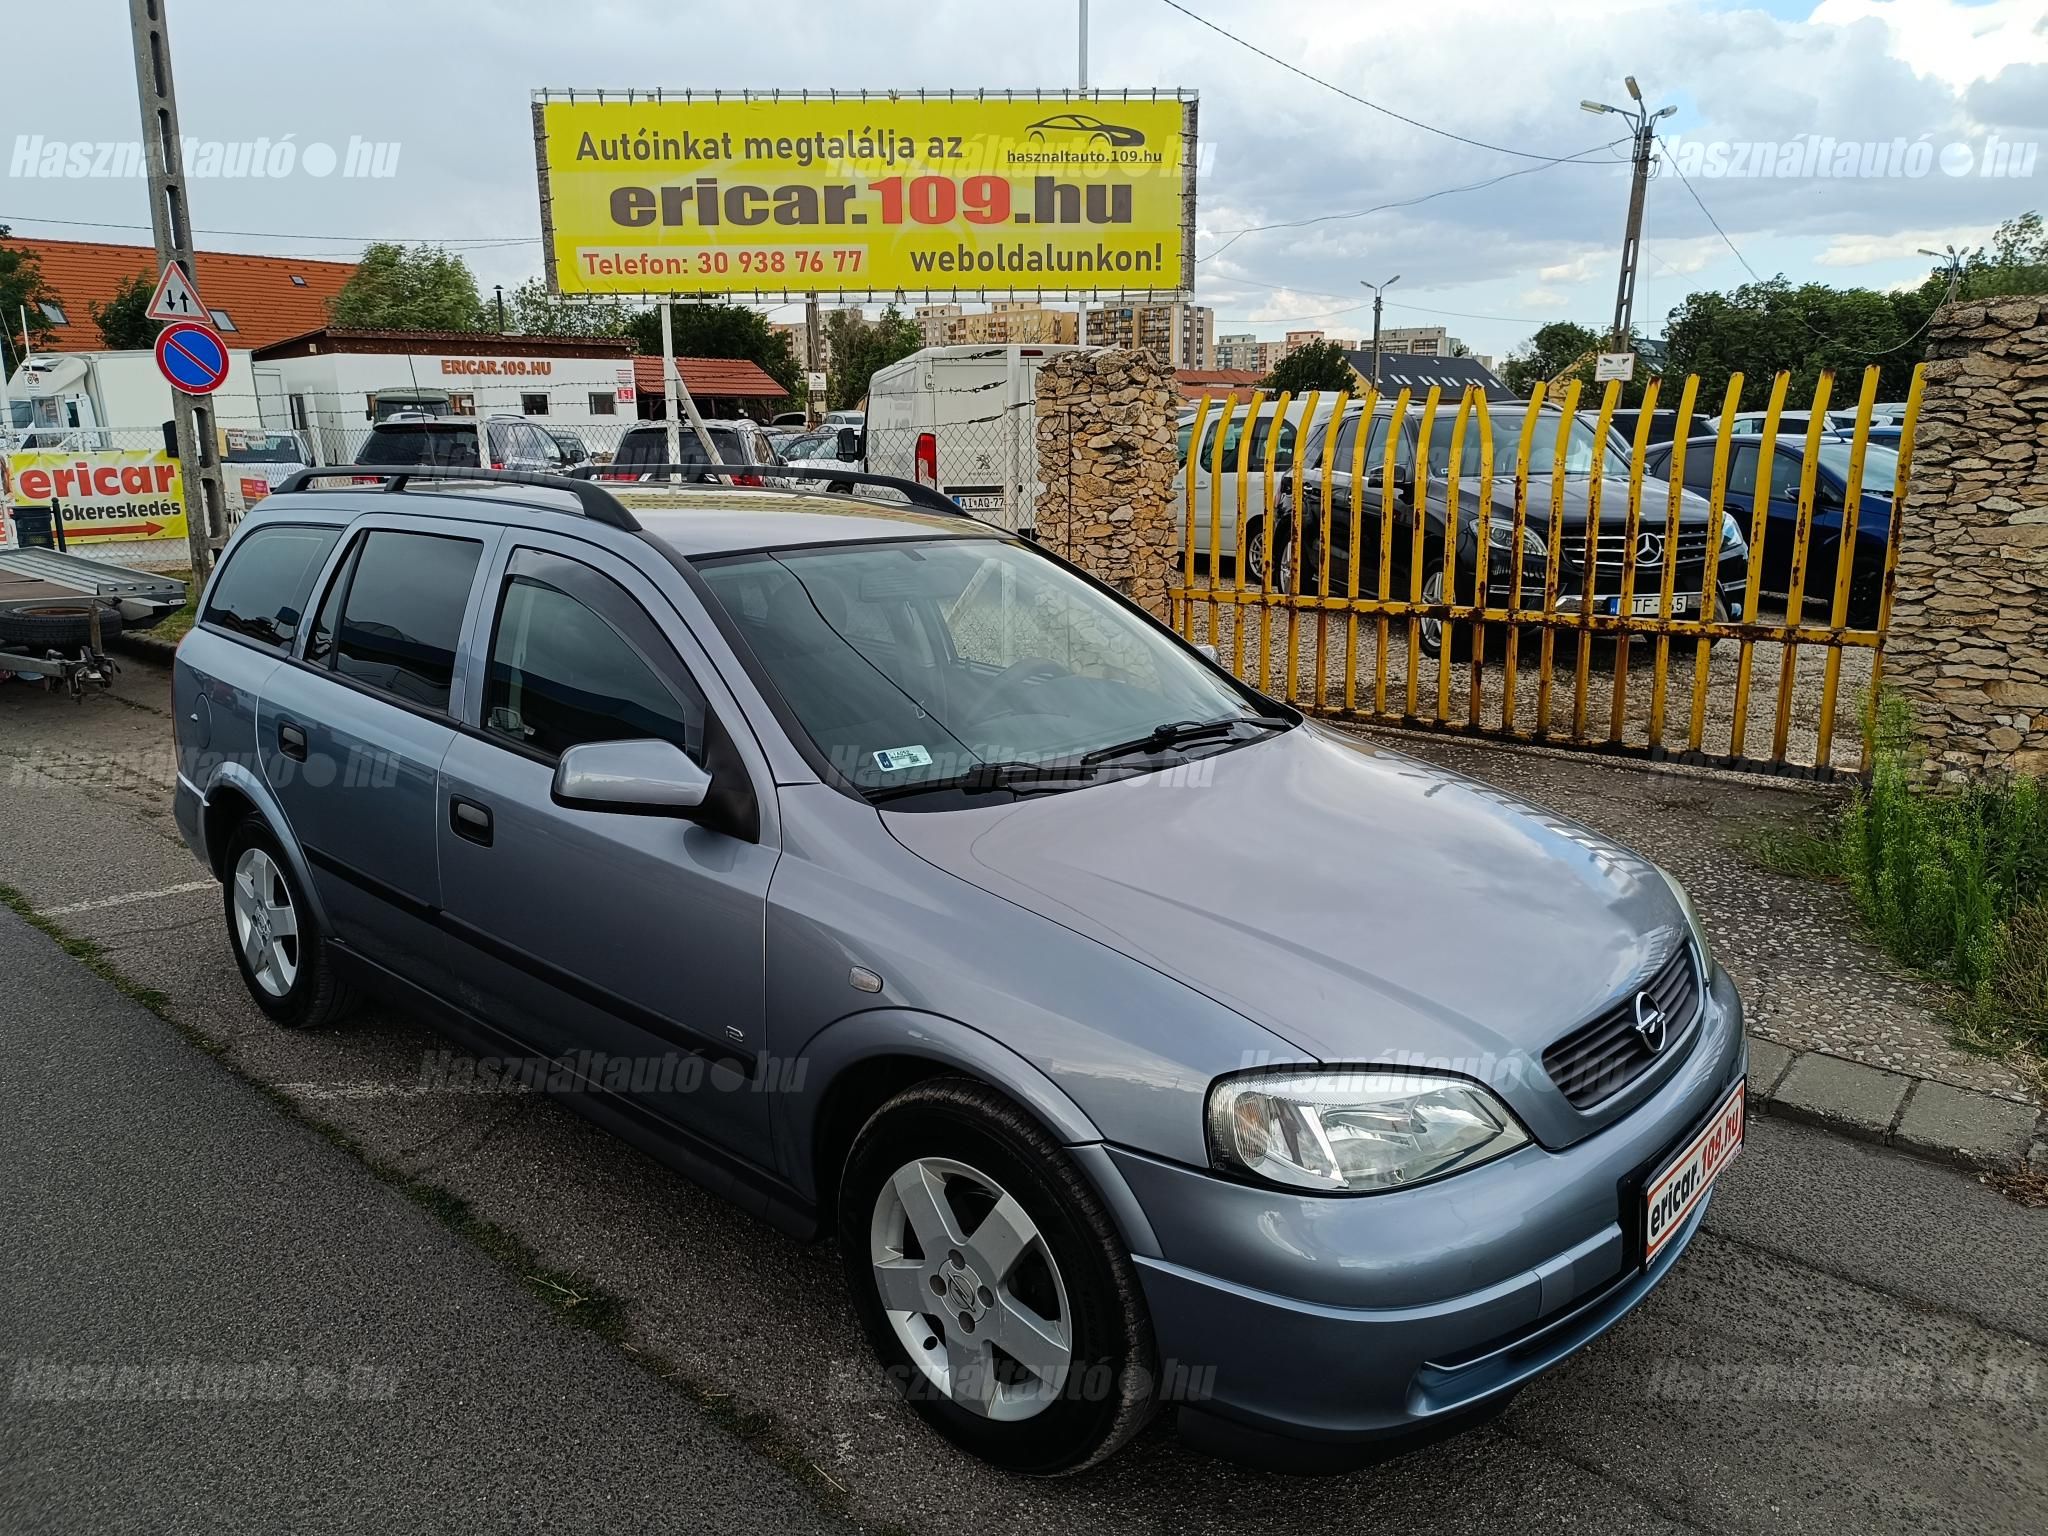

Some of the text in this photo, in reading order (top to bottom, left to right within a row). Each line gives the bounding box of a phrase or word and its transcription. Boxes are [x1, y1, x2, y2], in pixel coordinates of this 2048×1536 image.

[576, 125, 963, 166] Autóinkat megtalálja az
[1007, 149, 1163, 162] hasznaltauto.109.hu
[609, 175, 1132, 227] ericar.109.hu
[583, 250, 862, 274] Telefon: 30 938 76 77
[910, 242, 1162, 272] weboldalunkon!
[441, 359, 551, 376] ERICAR.109.HU
[20, 462, 175, 499] ericar
[52, 499, 181, 521] ókereskedés
[1650, 1106, 1740, 1237] ericar.109.hu
